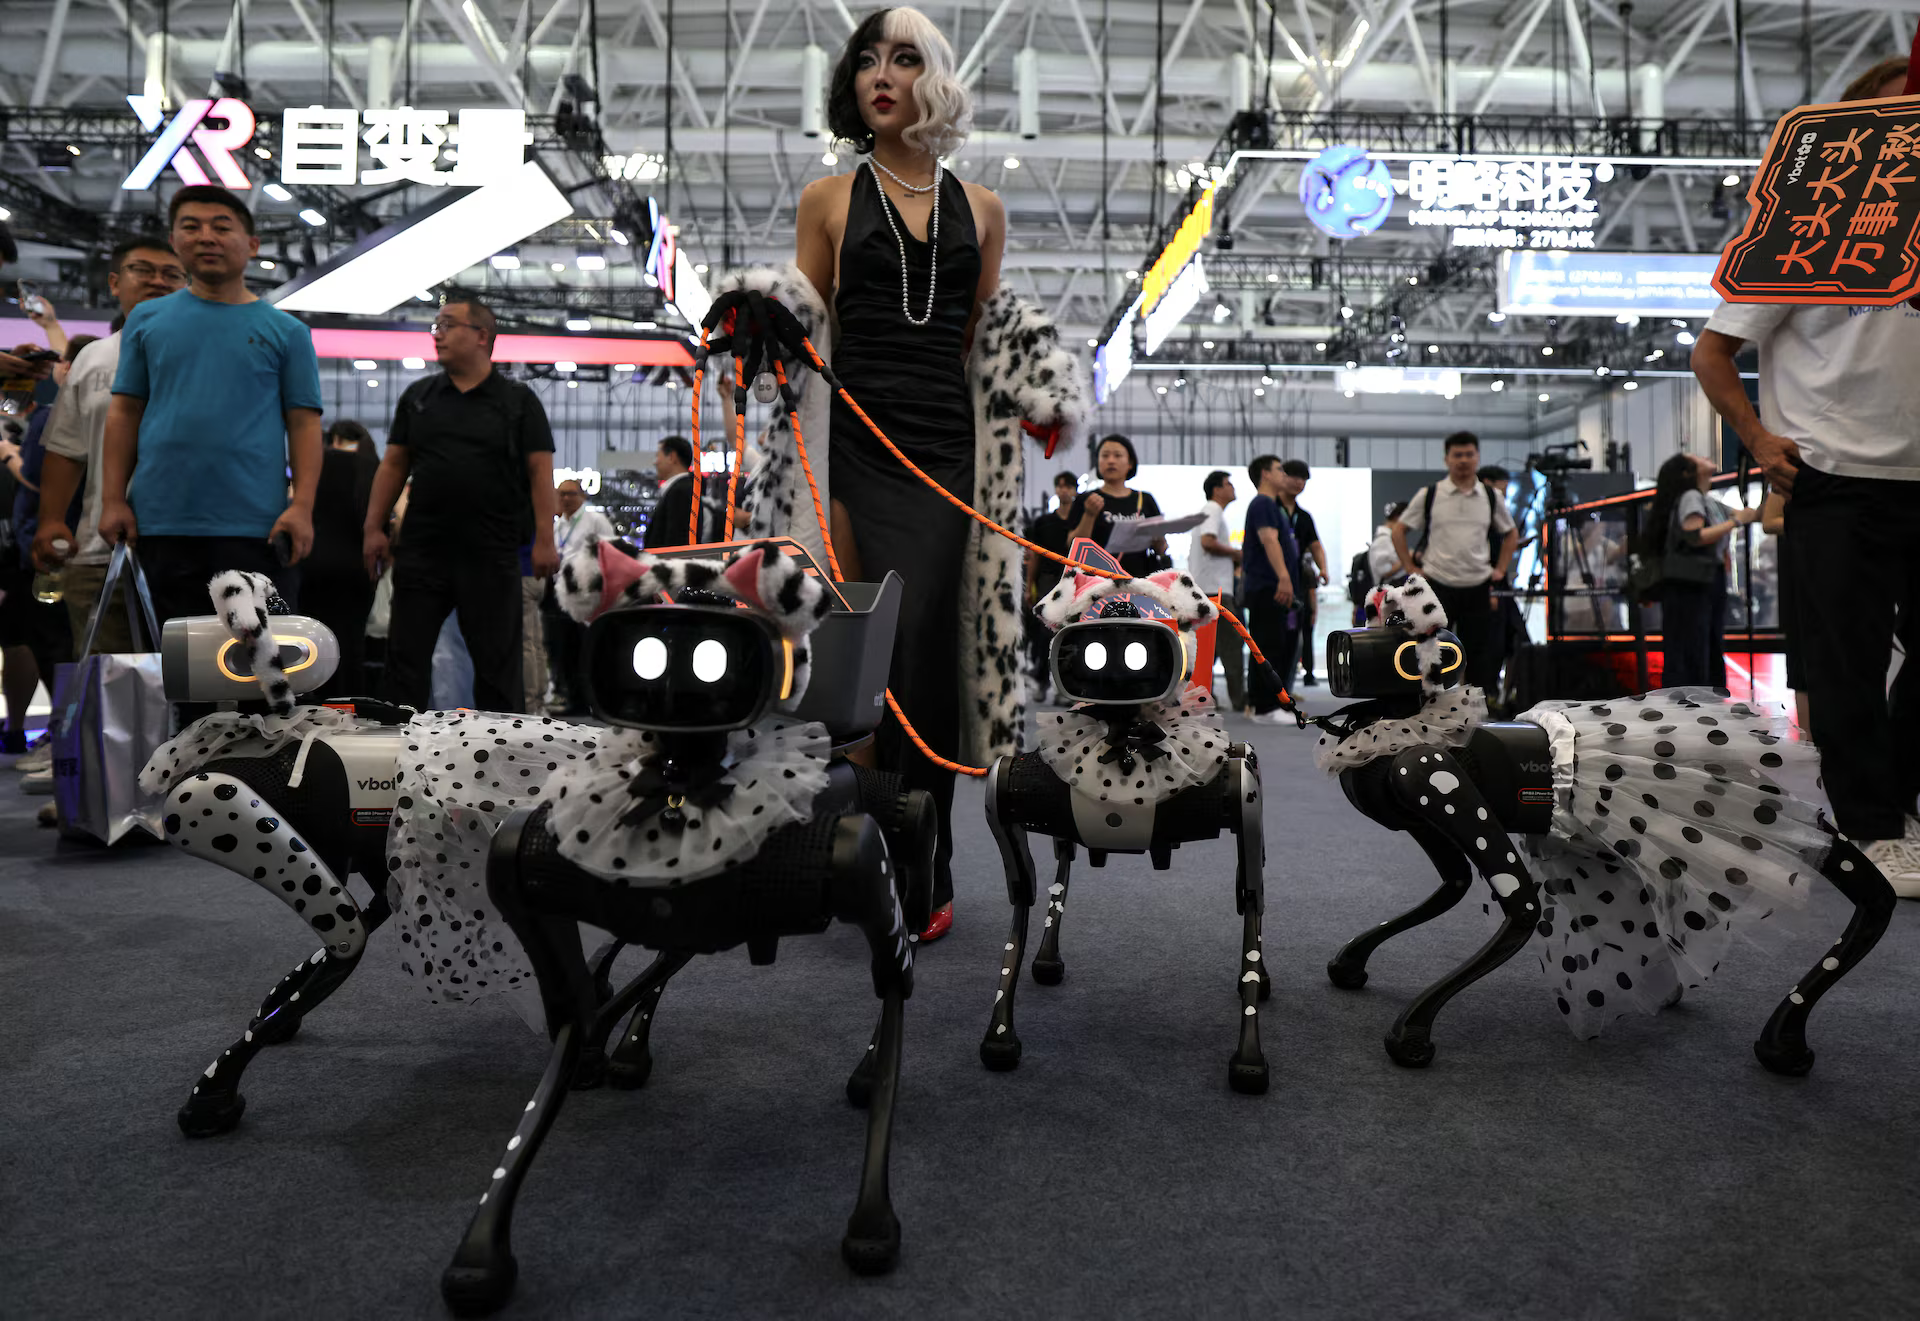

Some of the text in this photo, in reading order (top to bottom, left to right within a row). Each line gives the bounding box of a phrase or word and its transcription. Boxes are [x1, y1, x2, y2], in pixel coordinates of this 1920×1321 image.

[1408, 160, 1596, 210] 明略科技
[1787, 154, 1808, 185] vbot
[1775, 127, 1874, 275] 大头大头
